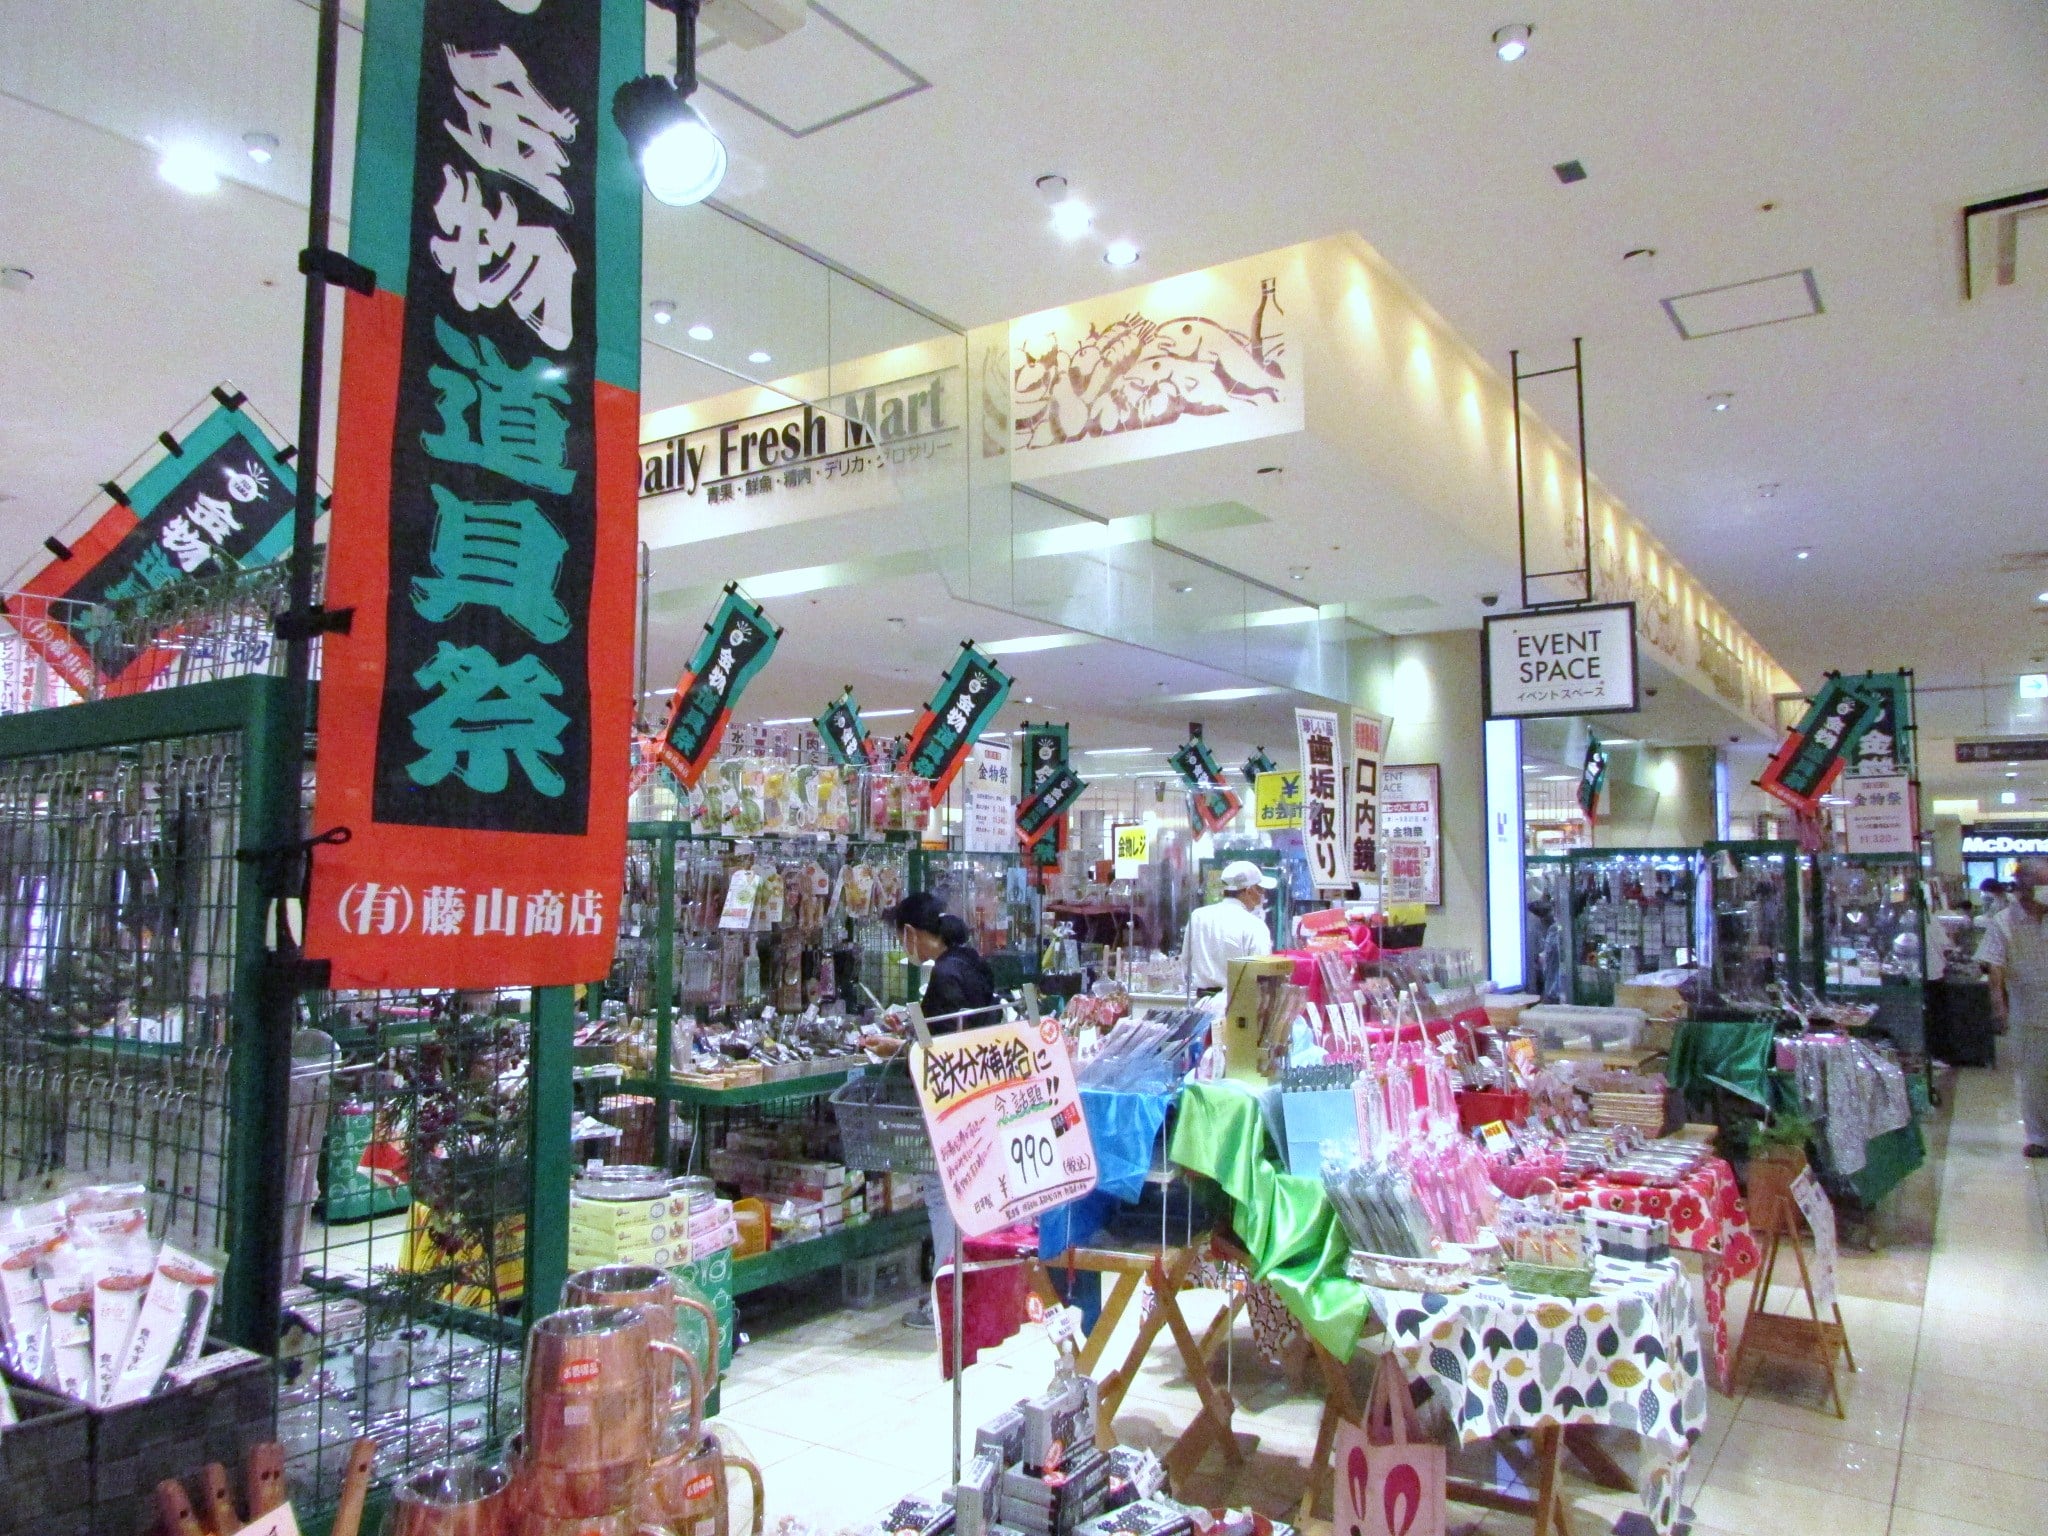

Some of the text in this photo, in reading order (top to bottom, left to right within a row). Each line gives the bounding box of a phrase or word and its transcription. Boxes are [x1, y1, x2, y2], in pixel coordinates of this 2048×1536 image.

[410, 42, 586, 800] 金物道具祭
[640, 375, 945, 496] aily Fresh Mart
[1517, 629, 1602, 658] EVENT
[1520, 656, 1601, 684] SPACE
[1517, 687, 1606, 701] イベントスペース
[978, 762, 1009, 784] 金物祭
[1383, 783, 1403, 793] ACE
[1384, 772, 1403, 782] ENT
[1307, 733, 1336, 878] 歯垢取り
[1354, 758, 1378, 873] 口内鏡
[1118, 835, 1147, 858] 金物レジ
[338, 882, 604, 937] (有)藤山商店
[923, 1037, 1053, 1103] 鉄分補給に
[1010, 1133, 1054, 1184] 990
